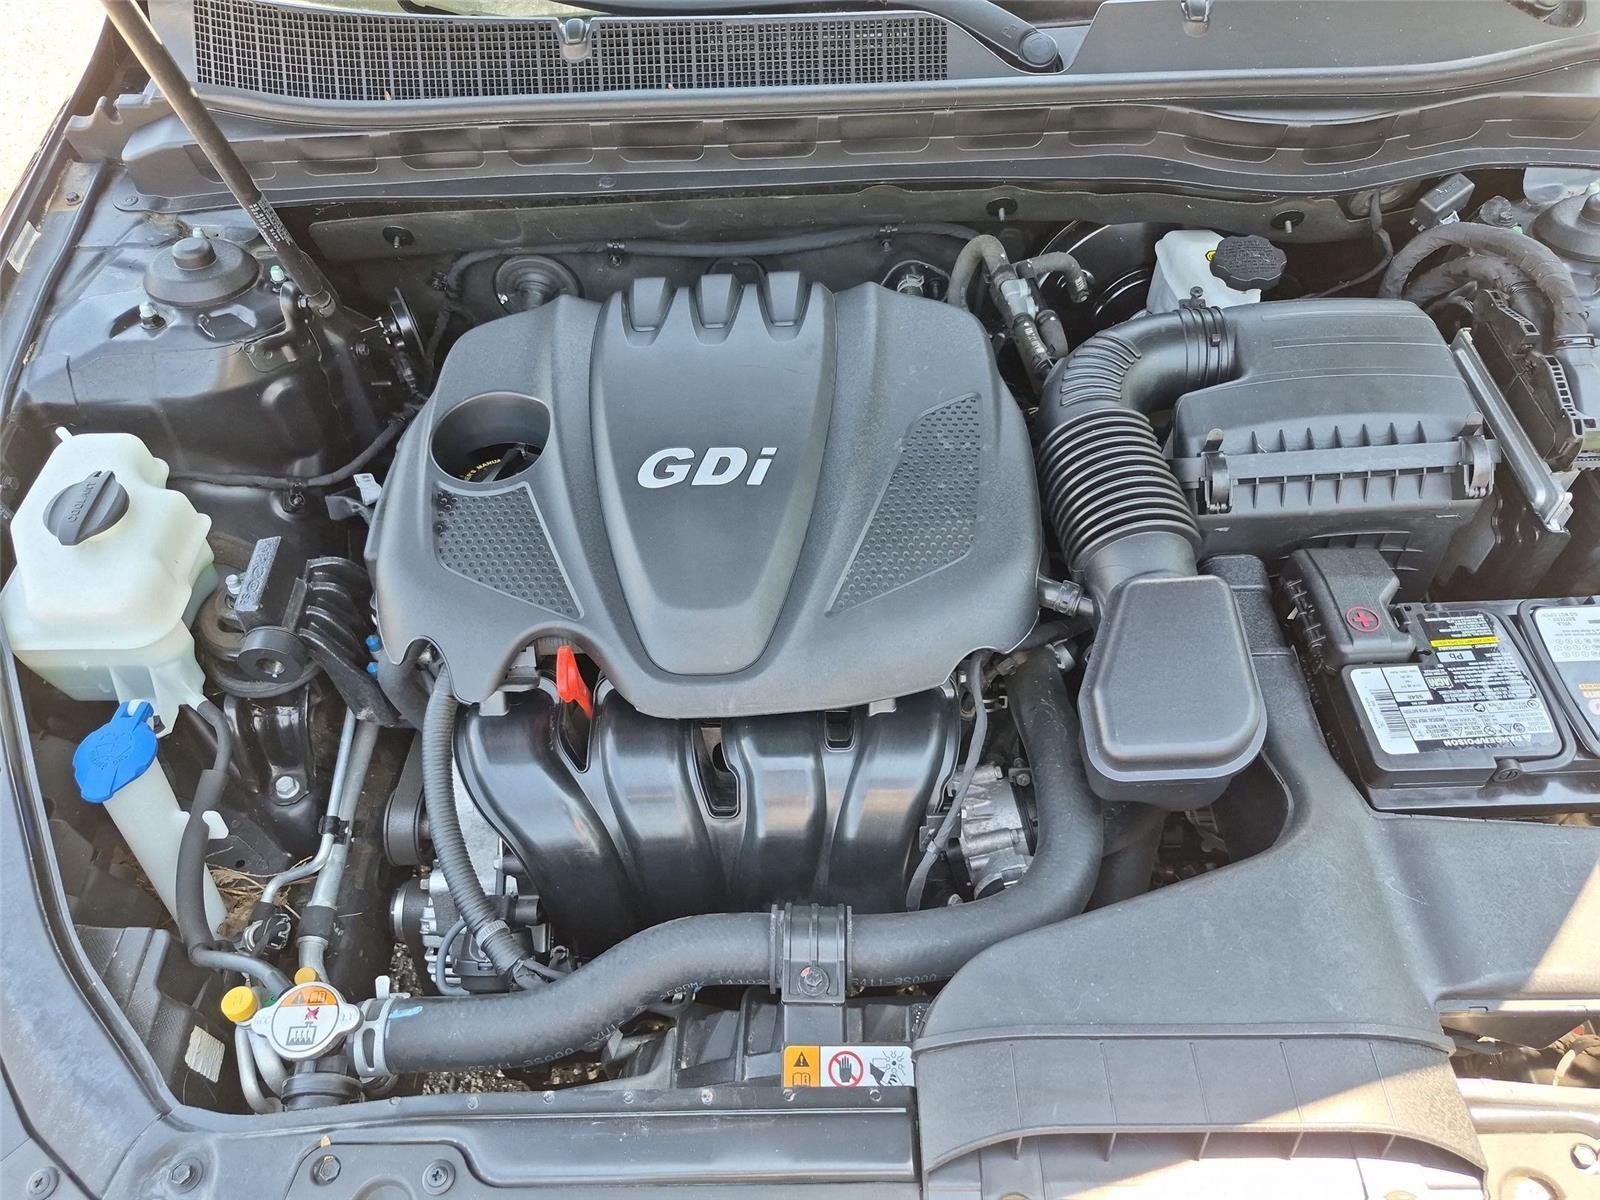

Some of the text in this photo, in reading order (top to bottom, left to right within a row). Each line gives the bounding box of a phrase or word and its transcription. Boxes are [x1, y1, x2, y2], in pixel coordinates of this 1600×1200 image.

[476, 459, 501, 470] MANUA
[637, 447, 777, 488] GDi
[68, 482, 96, 522] COOLANT
[1448, 652, 1464, 660] Pb
[1427, 676, 1450, 687] AGM
